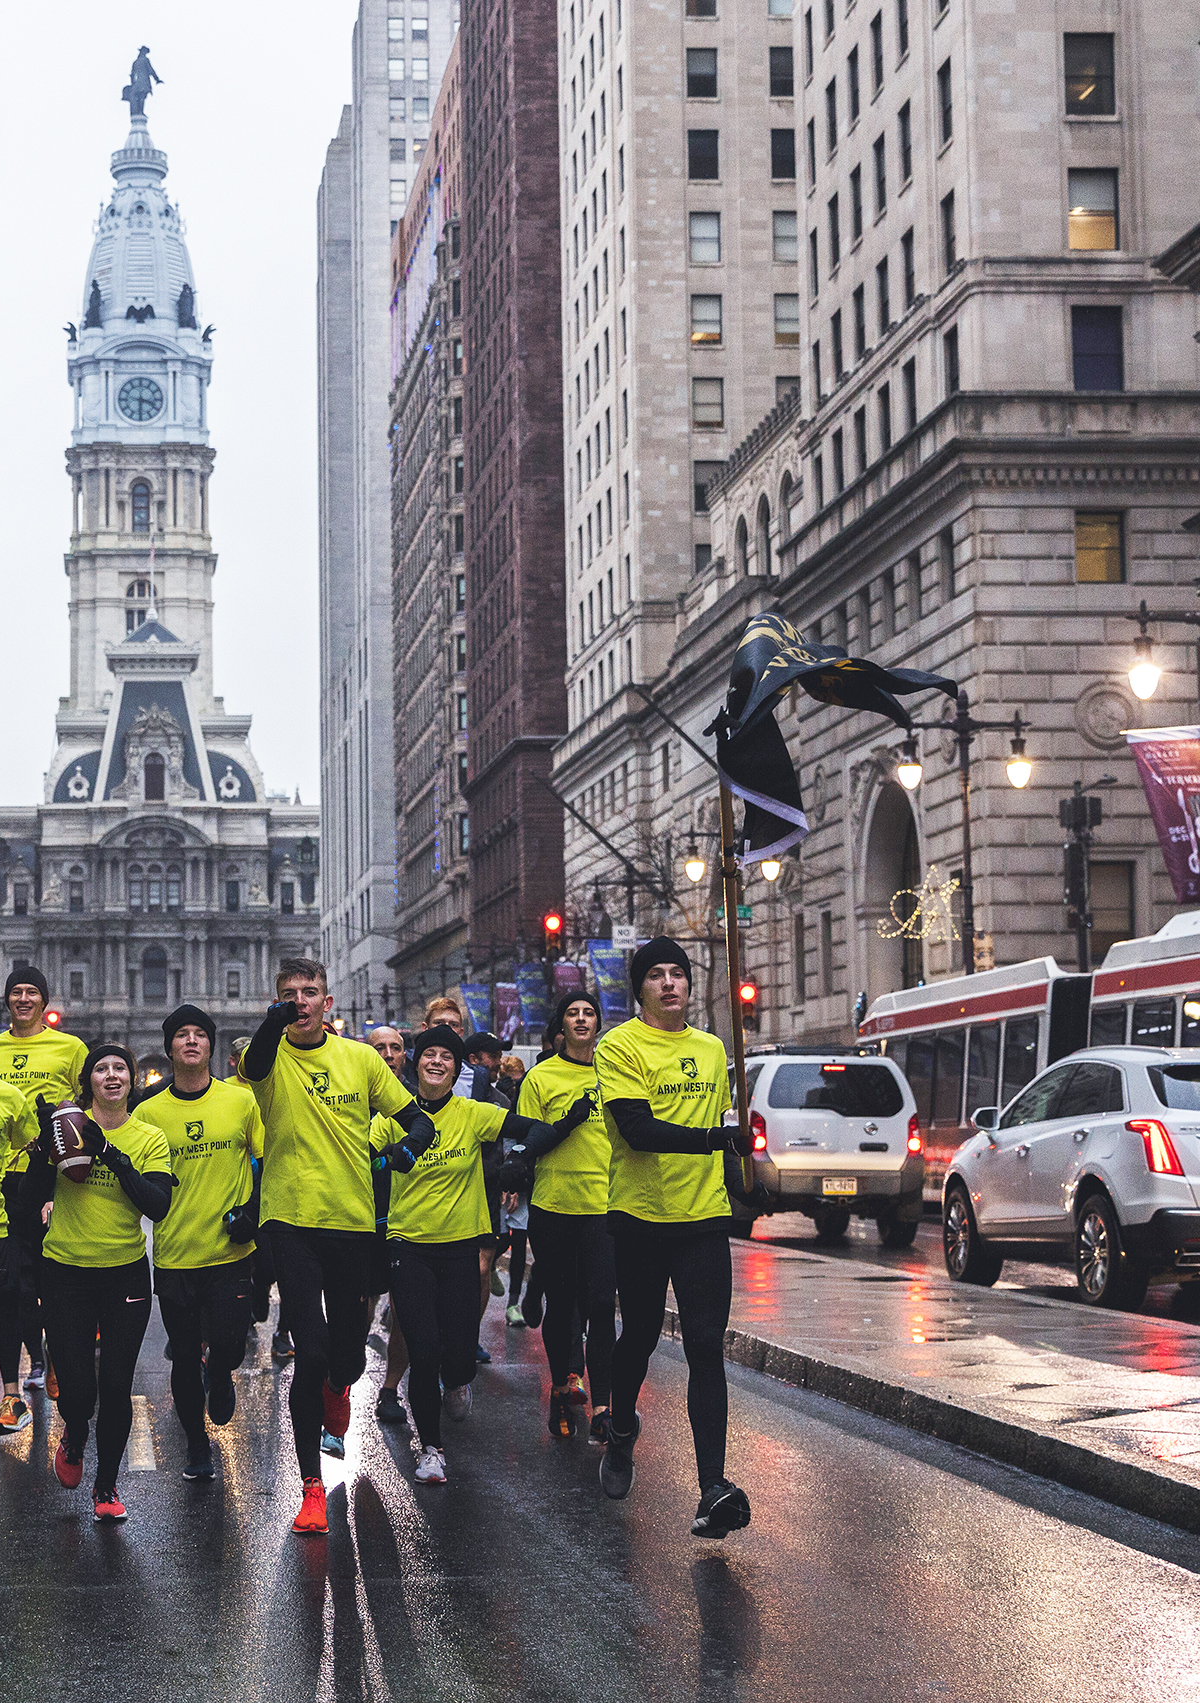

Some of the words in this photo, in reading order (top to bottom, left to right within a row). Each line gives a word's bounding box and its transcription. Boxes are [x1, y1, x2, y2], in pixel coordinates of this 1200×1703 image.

[9, 1071, 29, 1079] WEST
[30, 1071, 51, 1080] POINT
[657, 1083, 682, 1095] ARMY
[683, 1082, 705, 1093] WEST
[338, 1092, 360, 1105] POINT
[169, 1146, 185, 1158] RMY
[186, 1144, 209, 1154] WEST
[210, 1140, 232, 1151] POINT
[422, 1152, 444, 1162] WEST
[444, 1147, 467, 1160] POINT
[184, 1153, 213, 1161] MARATHON
[85, 1180, 114, 1188] ARATHON
